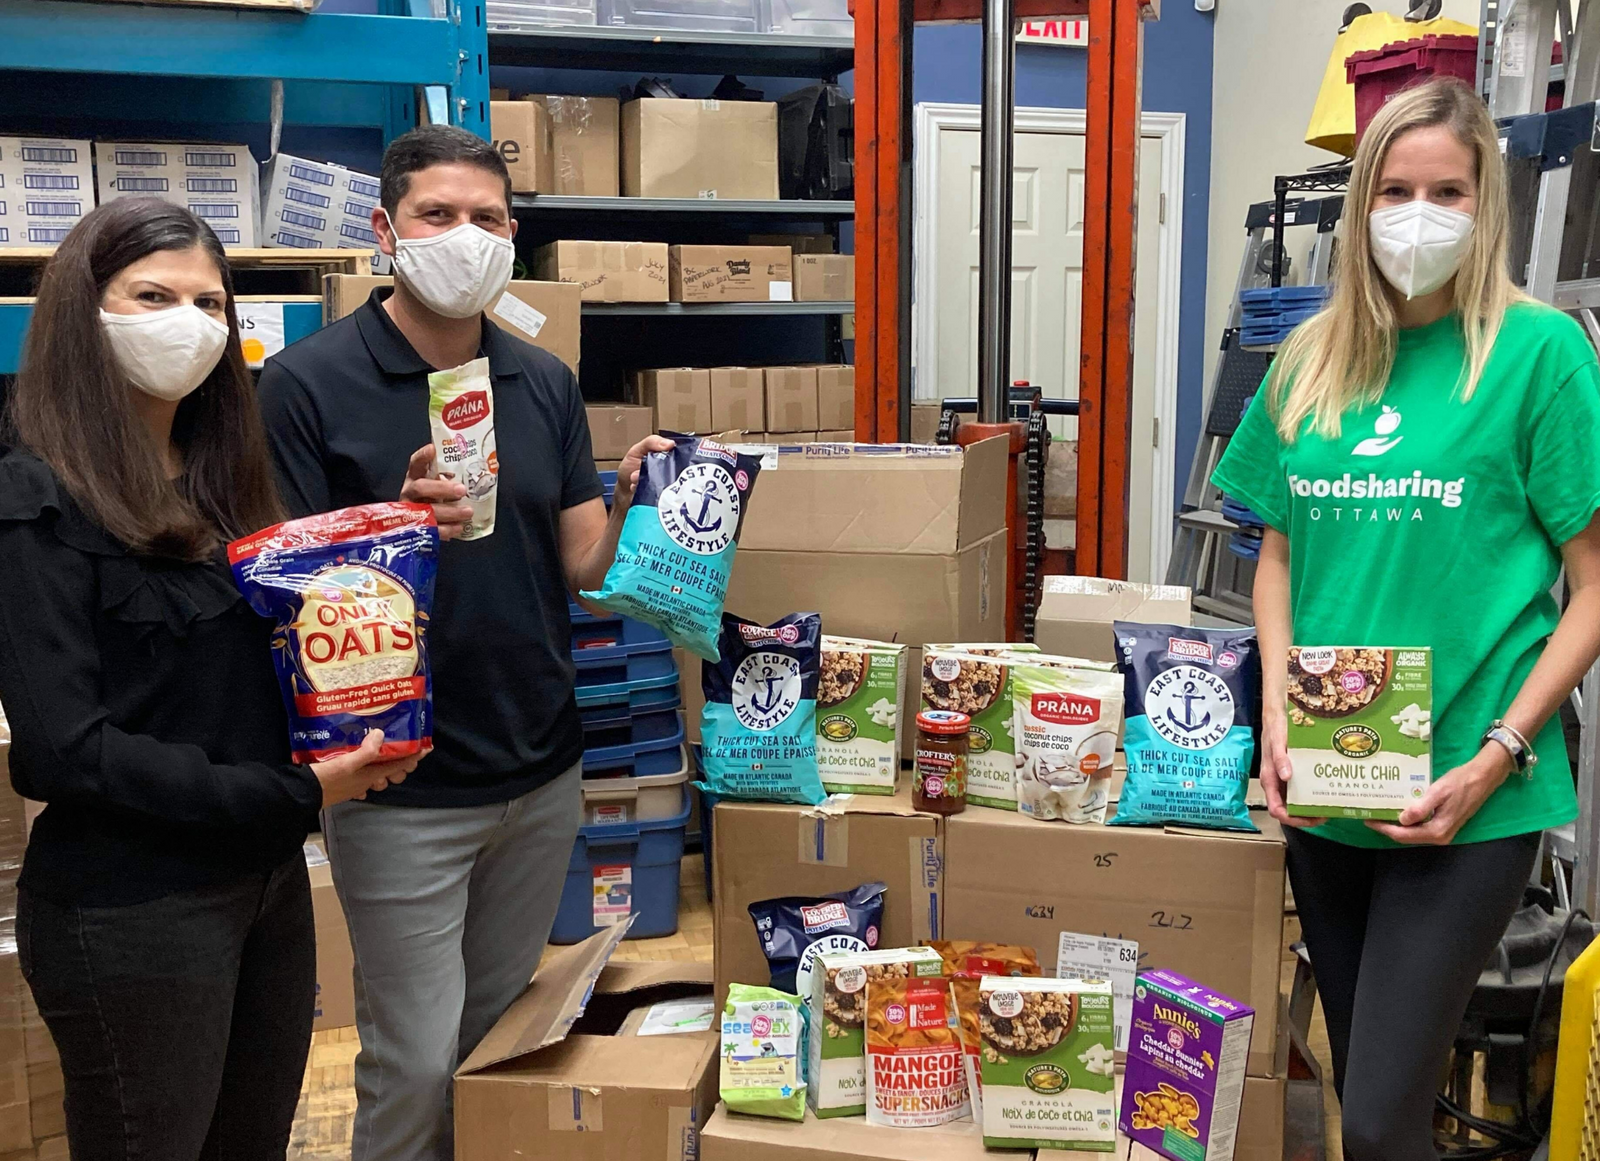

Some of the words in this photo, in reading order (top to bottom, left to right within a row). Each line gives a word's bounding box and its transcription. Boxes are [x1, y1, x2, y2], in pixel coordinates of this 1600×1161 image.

[726, 258, 751, 270] Dandy
[703, 439, 737, 459] BRIDGE
[669, 465, 707, 495] EAST
[712, 467, 740, 516] COAST
[1288, 469, 1465, 508] Foodsharing
[1310, 507, 1424, 522] OTTAWA
[661, 508, 730, 553] LIFESTYLE
[637, 541, 666, 559] THICK
[668, 552, 690, 568] CUT
[689, 560, 708, 578] SEA
[709, 568, 726, 587] SALT
[617, 552, 632, 565] SEL
[633, 555, 647, 568] DE
[649, 560, 671, 577] MER
[673, 568, 705, 592] COUPE
[636, 584, 654, 596] MADE
[653, 590, 660, 599] IN
[659, 593, 686, 609] ATLANTIC
[685, 602, 707, 617] CANADA
[656, 606, 679, 621] CANADA
[678, 614, 709, 634] ATLANTIQUE
[305, 621, 415, 664] OATS
[1172, 640, 1209, 652] COVERED
[1172, 646, 1210, 658] BRIDGE
[1302, 652, 1316, 660] NEW
[1317, 650, 1334, 660] LOOK
[1398, 652, 1426, 660] ALWAYS
[735, 655, 758, 686] EAST
[1150, 668, 1182, 697] EAST
[1188, 668, 1231, 704] COAST
[1344, 676, 1361, 684] 50%
[1346, 682, 1362, 690] OFF
[316, 689, 369, 704] Gluten-Free
[370, 682, 395, 694] Quick
[397, 679, 413, 688] Oats
[316, 702, 342, 713] Gruau
[344, 698, 371, 710] rapide
[373, 694, 391, 704] sans
[392, 688, 415, 701] gluten
[735, 698, 795, 729] LIFESTYLE
[844, 717, 856, 728] PATH
[1024, 732, 1051, 742] coconut
[1052, 734, 1073, 744] chips
[1152, 714, 1227, 748] LIFESTYLE
[1334, 726, 1363, 741] NATURE'S
[1363, 727, 1378, 741] PATH
[717, 735, 741, 746] THICK
[743, 736, 759, 746] CUT
[761, 736, 779, 746] SEA
[782, 735, 803, 746] SALT
[1024, 740, 1040, 749] chips
[1040, 740, 1050, 749] de
[1050, 743, 1070, 751] coco
[716, 747, 726, 758] DE
[729, 748, 748, 759] MER
[751, 748, 780, 760] COUPE
[916, 750, 956, 762] CROFTER'S
[1140, 750, 1168, 761] THICK
[1171, 752, 1190, 764] CUT
[1193, 756, 1212, 767] SEA
[1214, 757, 1239, 768] SALT
[1344, 750, 1370, 758] ORGANIC
[850, 757, 858, 767] et
[984, 768, 992, 780] et
[1142, 764, 1153, 774] DE
[1157, 764, 1178, 776] MER
[1181, 766, 1213, 779] COUPE
[1328, 782, 1385, 790] GRANOLA
[1151, 789, 1168, 798] MADE
[1168, 790, 1174, 798] IN
[1175, 790, 1202, 800] ATLANTIC
[1202, 793, 1226, 802] CANADA
[1140, 802, 1168, 812] FABRIQUÉ
[1168, 804, 1177, 812] AU
[1177, 805, 1200, 814] CANADA
[1201, 806, 1234, 816] ATLANTIQUE
[924, 838, 936, 867] Purity
[1093, 852, 1119, 868] 25
[926, 866, 938, 888] Life
[805, 902, 842, 918] COVERED
[808, 910, 845, 925] BRIDGE
[801, 942, 824, 974] EAST
[1120, 948, 1137, 962] 634
[888, 1008, 904, 1016] 50%
[917, 1003, 937, 1012] Made
[917, 1018, 943, 1028] Nature
[1152, 1002, 1202, 1040] Annie's
[1143, 1034, 1175, 1054] Cheddar
[1175, 1050, 1204, 1070] Bunnies
[874, 1053, 963, 1074] MANGOE
[1140, 1040, 1164, 1058] Lapins
[1164, 1054, 1175, 1064] au
[1174, 1060, 1205, 1080] cheddar
[1026, 1065, 1053, 1077] NATURE'S
[1053, 1066, 1067, 1079] PATH
[875, 1087, 892, 1097] SWEET
[897, 1089, 916, 1097] TANGY
[920, 1088, 942, 1097] DOUCES
[1021, 1100, 1074, 1108] GRANOLA
[1025, 1110, 1036, 1120] de
[1062, 1110, 1072, 1121] et
